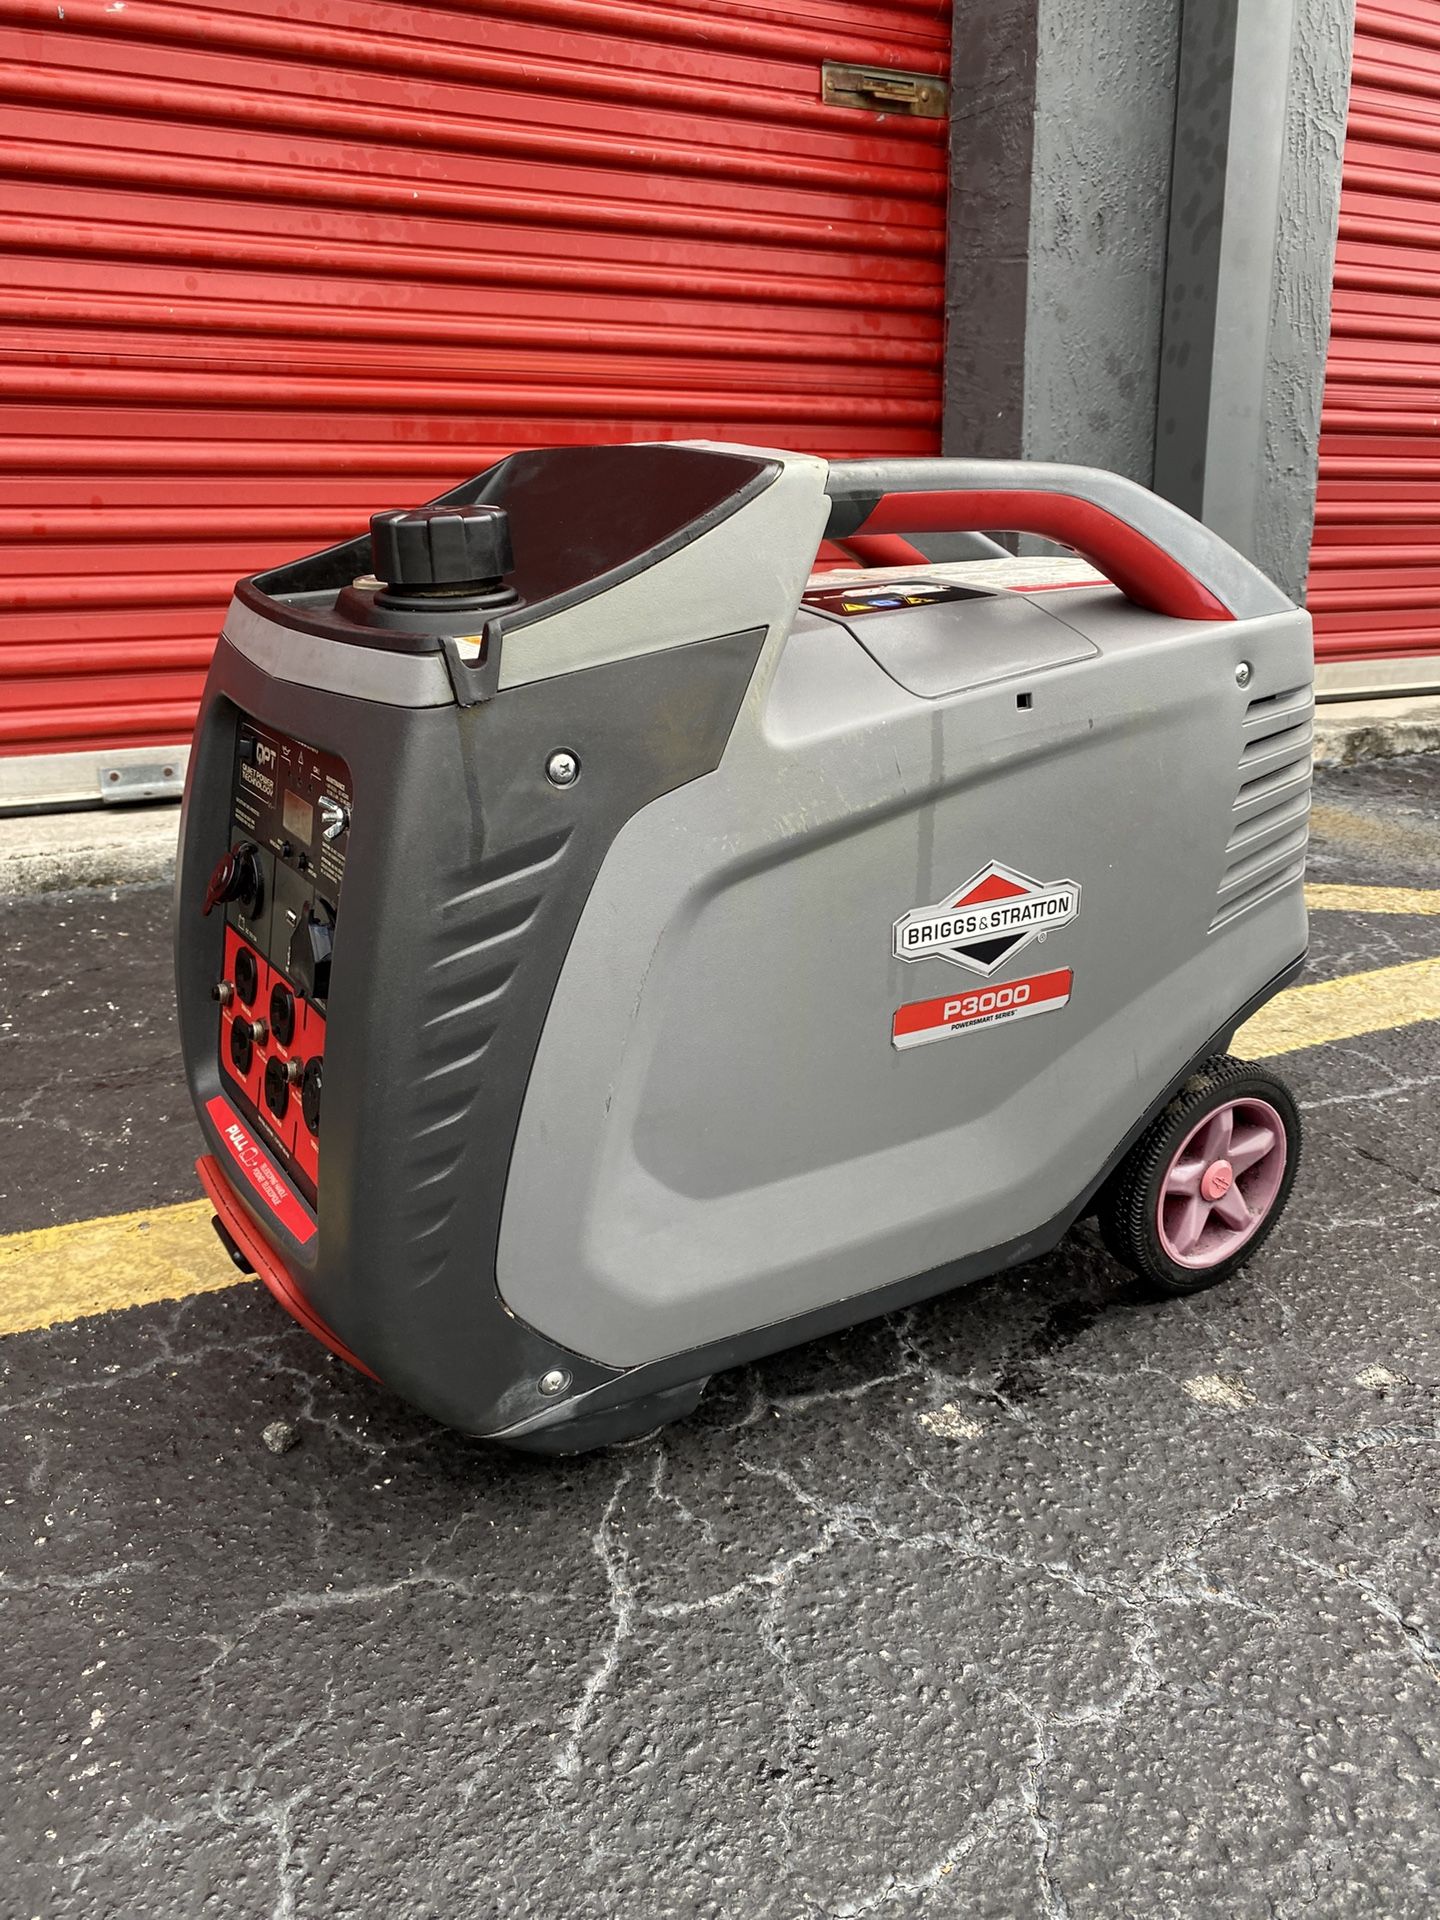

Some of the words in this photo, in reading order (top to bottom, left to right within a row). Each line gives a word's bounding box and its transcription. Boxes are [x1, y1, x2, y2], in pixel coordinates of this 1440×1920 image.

[943, 984, 1031, 1021] P3000
[951, 1015, 994, 1031] POWERSMART
[225, 1123, 248, 1152] PULL
